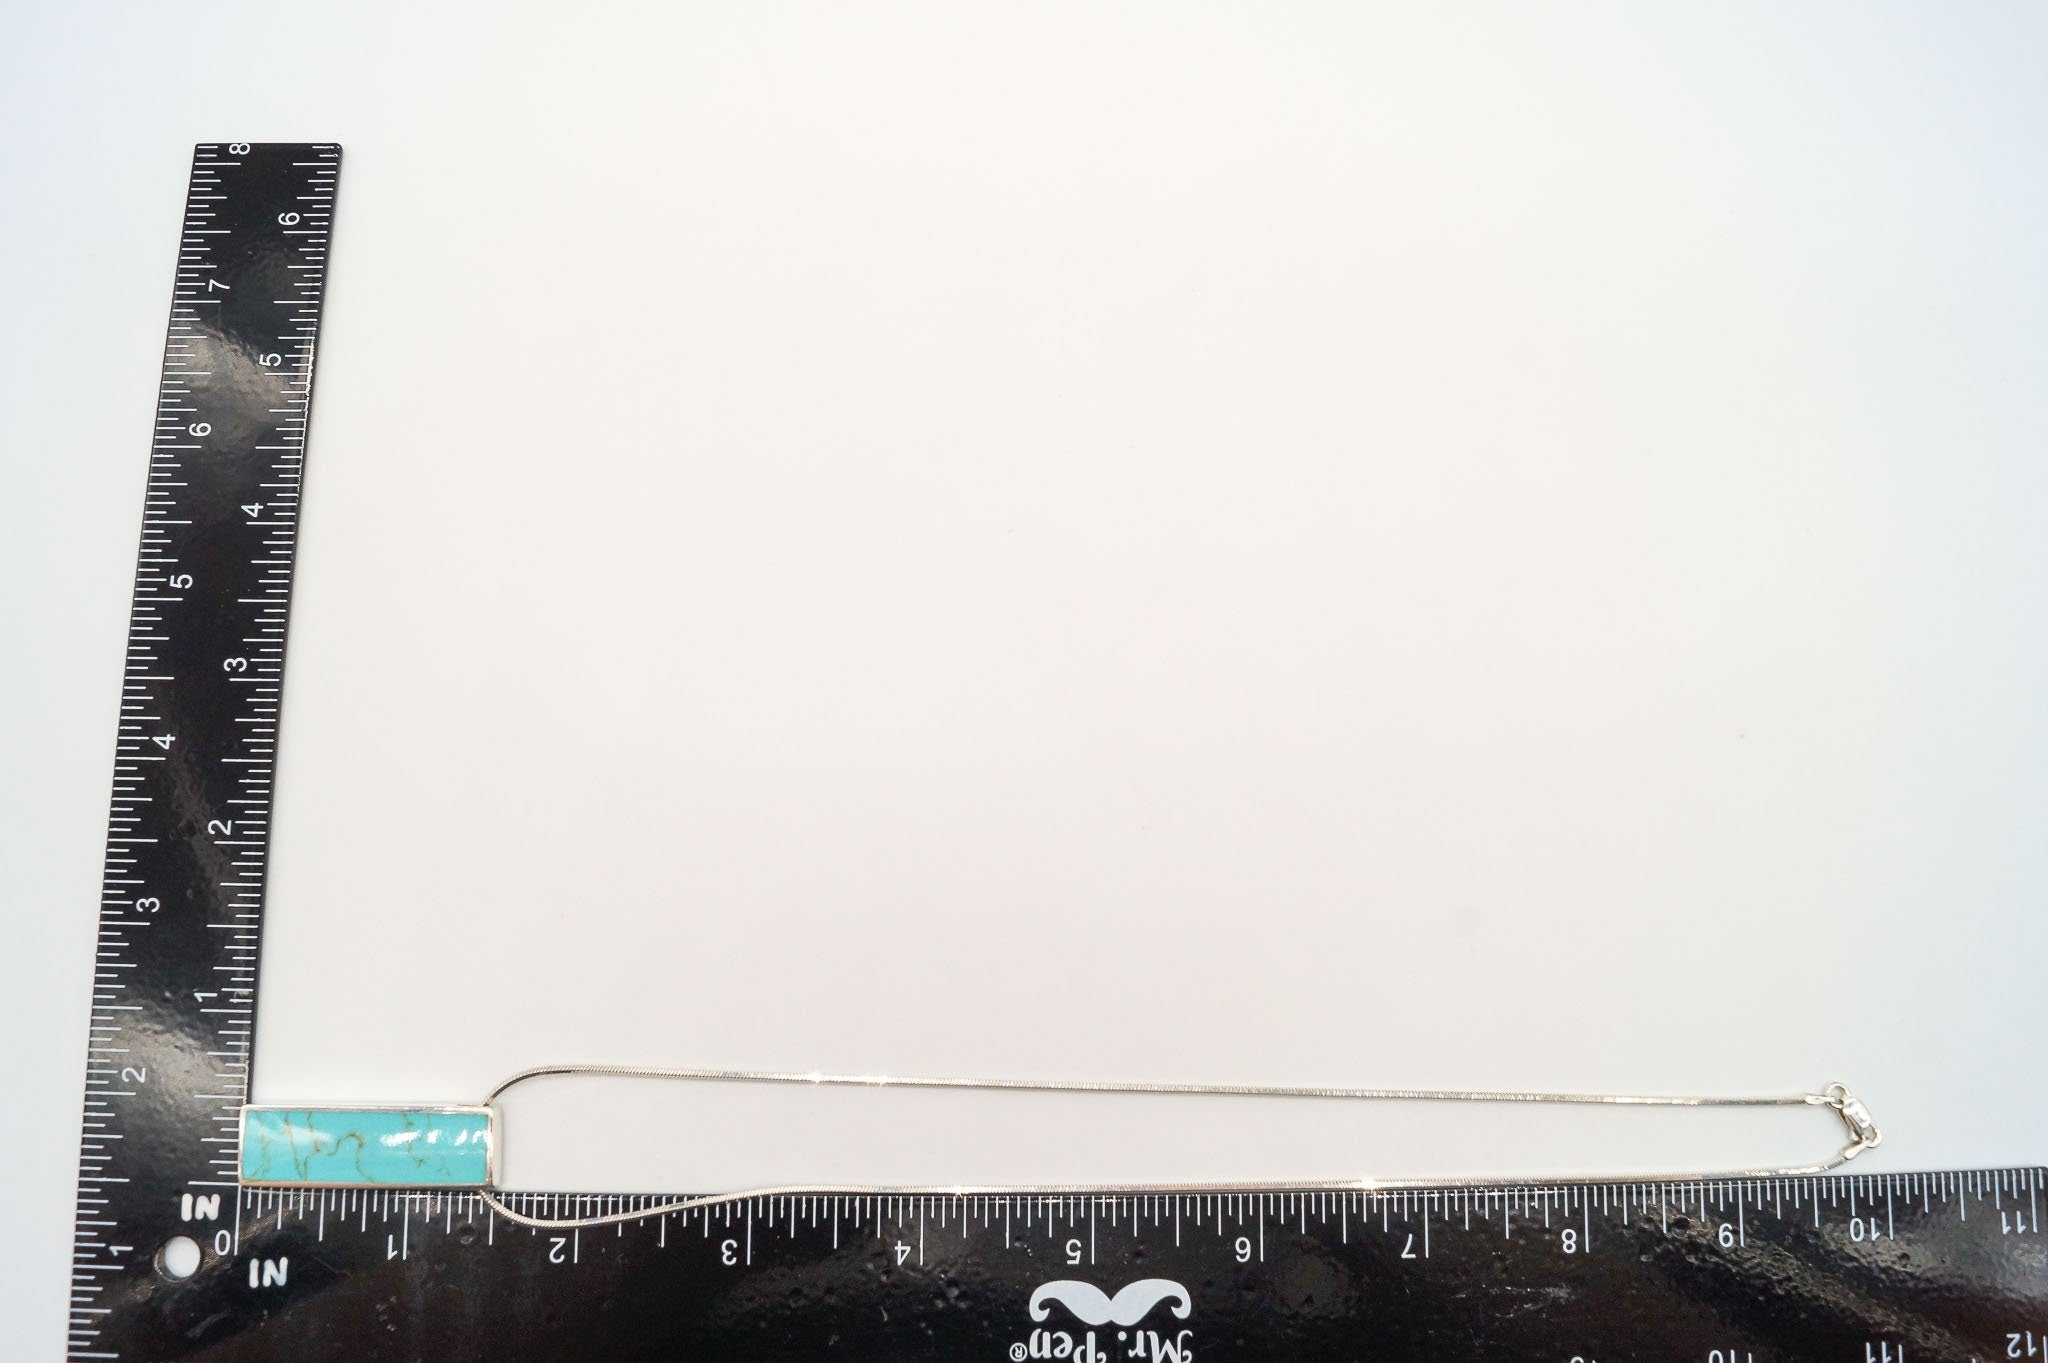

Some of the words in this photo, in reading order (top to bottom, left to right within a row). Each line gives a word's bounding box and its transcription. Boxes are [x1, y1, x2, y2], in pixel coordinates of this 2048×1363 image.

[229, 142, 251, 155] 8
[278, 212, 300, 225] 6
[208, 279, 231, 292] 7
[259, 353, 281, 366] 5
[189, 423, 211, 436] 6
[241, 503, 264, 517] 4
[170, 574, 193, 589] 5
[224, 657, 247, 672] 3
[152, 734, 176, 749] 4
[208, 820, 232, 835] 2
[136, 897, 160, 912] 3
[194, 993, 217, 1002] 1
[122, 1067, 145, 1083] 2
[181, 1193, 220, 1221] IN
[1850, 1217, 1880, 1242] 10
[2001, 1211, 2026, 1235] 11
[214, 1230, 231, 1255] 0
[387, 1235, 397, 1260] 1
[1401, 1234, 1416, 1258] 7
[1561, 1229, 1577, 1253] 8
[1719, 1223, 1734, 1248] 9
[109, 1245, 133, 1256] 1
[549, 1238, 566, 1263] 2
[721, 1239, 737, 1265] 3
[895, 1240, 911, 1266] 4
[1066, 1239, 1081, 1264] 5
[1235, 1237, 1251, 1262] 6
[249, 1256, 288, 1288] IN
[1118, 1330, 1193, 1363] Mr.
[1866, 1341, 1892, 1363] 11
[2006, 1331, 2037, 1359] 12
